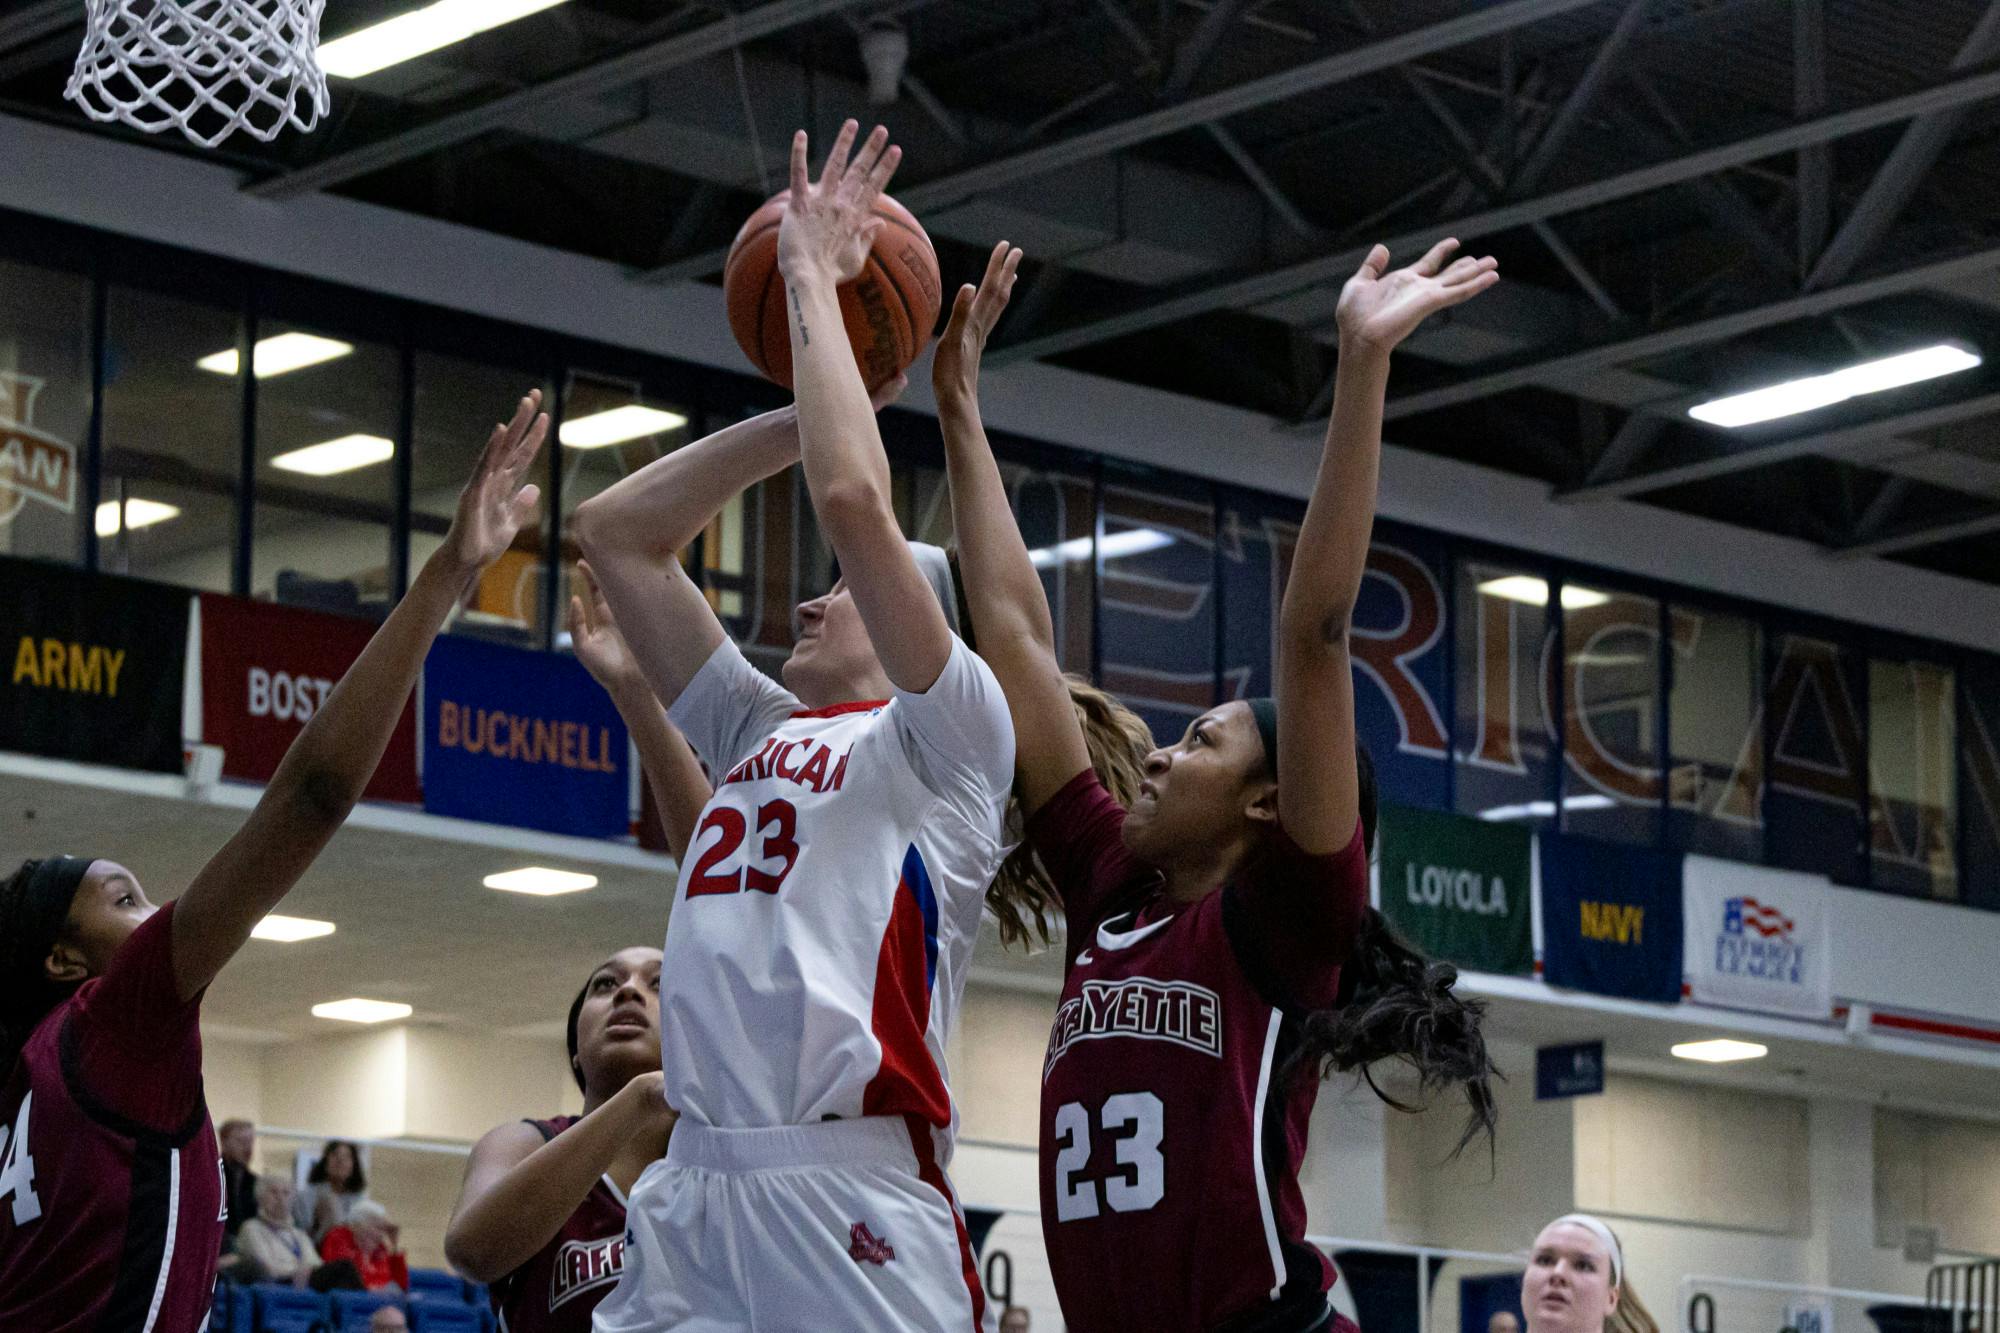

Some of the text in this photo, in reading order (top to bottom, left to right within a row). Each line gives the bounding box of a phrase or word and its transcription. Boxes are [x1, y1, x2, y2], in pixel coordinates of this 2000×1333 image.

[13, 636, 126, 697] ARMY
[438, 701, 616, 771] BUCKNELL
[686, 799, 800, 900] 23
[1406, 863, 1507, 917] LOYOLA
[1580, 901, 1644, 945] NAVY
[1055, 1091, 1164, 1221] 23
